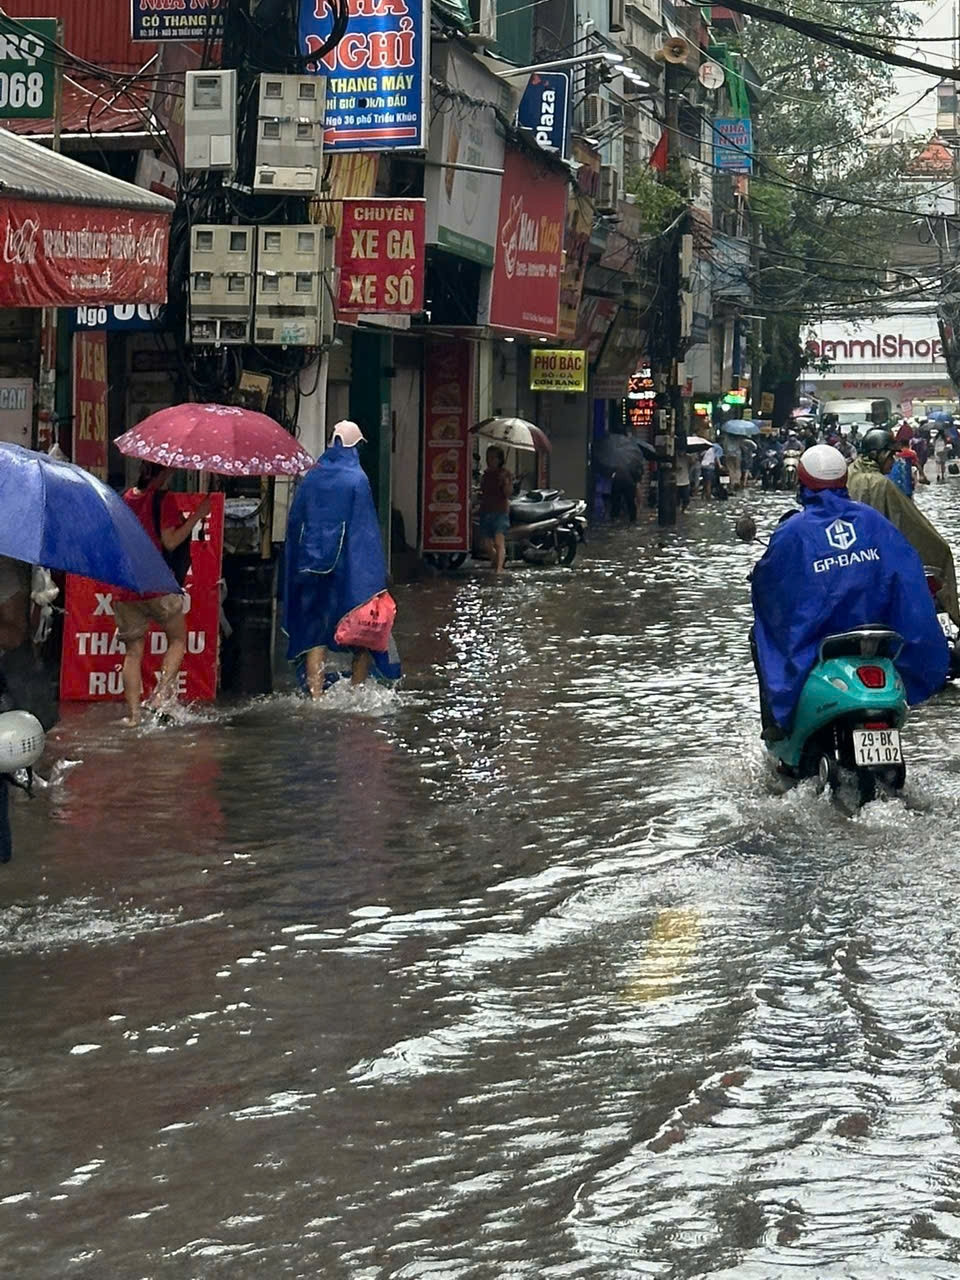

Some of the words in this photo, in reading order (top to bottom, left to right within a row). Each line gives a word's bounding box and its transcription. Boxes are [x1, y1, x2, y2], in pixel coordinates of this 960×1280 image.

[142, 13, 160, 27] CÓ
[163, 15, 208, 27] THANG
[0, 33, 45, 66] RỌ
[305, 16, 415, 73] NGHỈ
[330, 76, 377, 94] THANG
[382, 72, 414, 92] MÁY
[344, 115, 355, 126] 36
[396, 112, 417, 123] Khúc
[354, 205, 415, 221] CHUYÊN
[350, 229, 379, 259] XE
[387, 229, 416, 260] GA
[349, 274, 377, 305] XE
[384, 264, 416, 306] SỐ
[860, 747, 899, 763] 141.02
